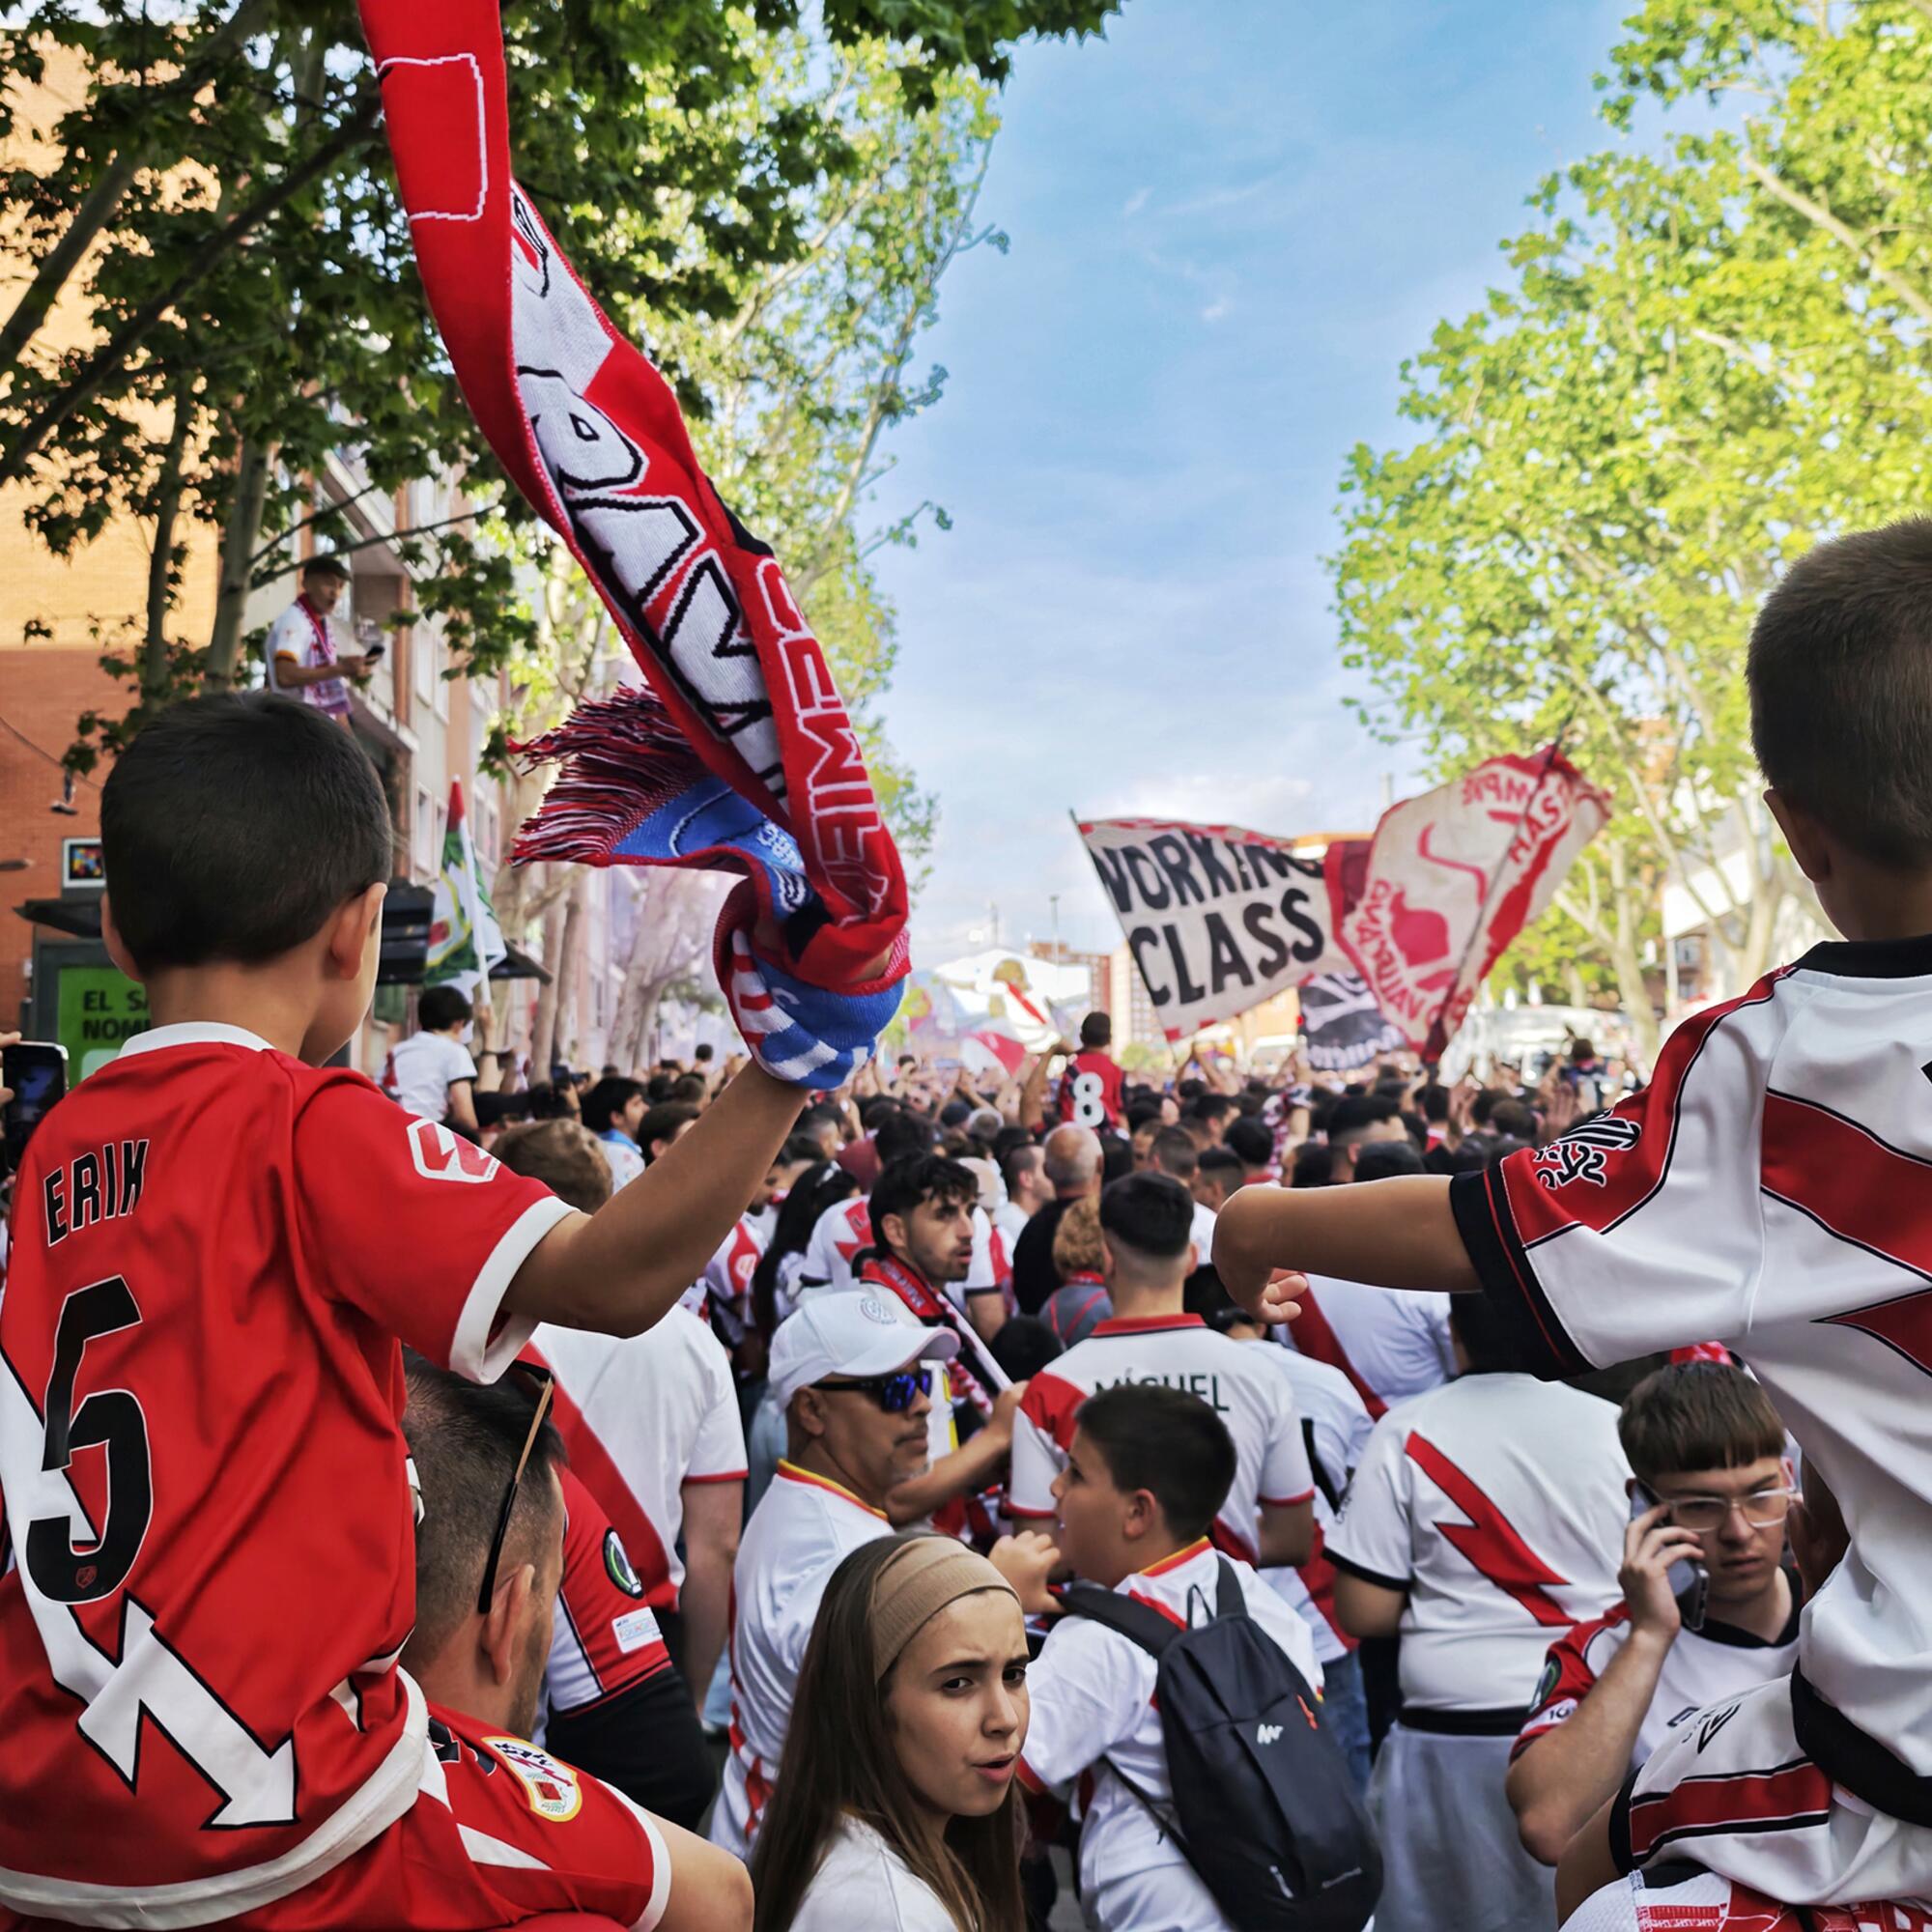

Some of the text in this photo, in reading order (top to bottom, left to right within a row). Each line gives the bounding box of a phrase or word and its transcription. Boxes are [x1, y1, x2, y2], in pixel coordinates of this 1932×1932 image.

[516, 365, 789, 813] RAY
[83, 989, 150, 1011] EL S
[1129, 888, 1324, 1007] CLASS
[1072, 1072, 1104, 1127] 8
[43, 1139, 150, 1248] ERIK
[26, 1274, 153, 1603] 5
